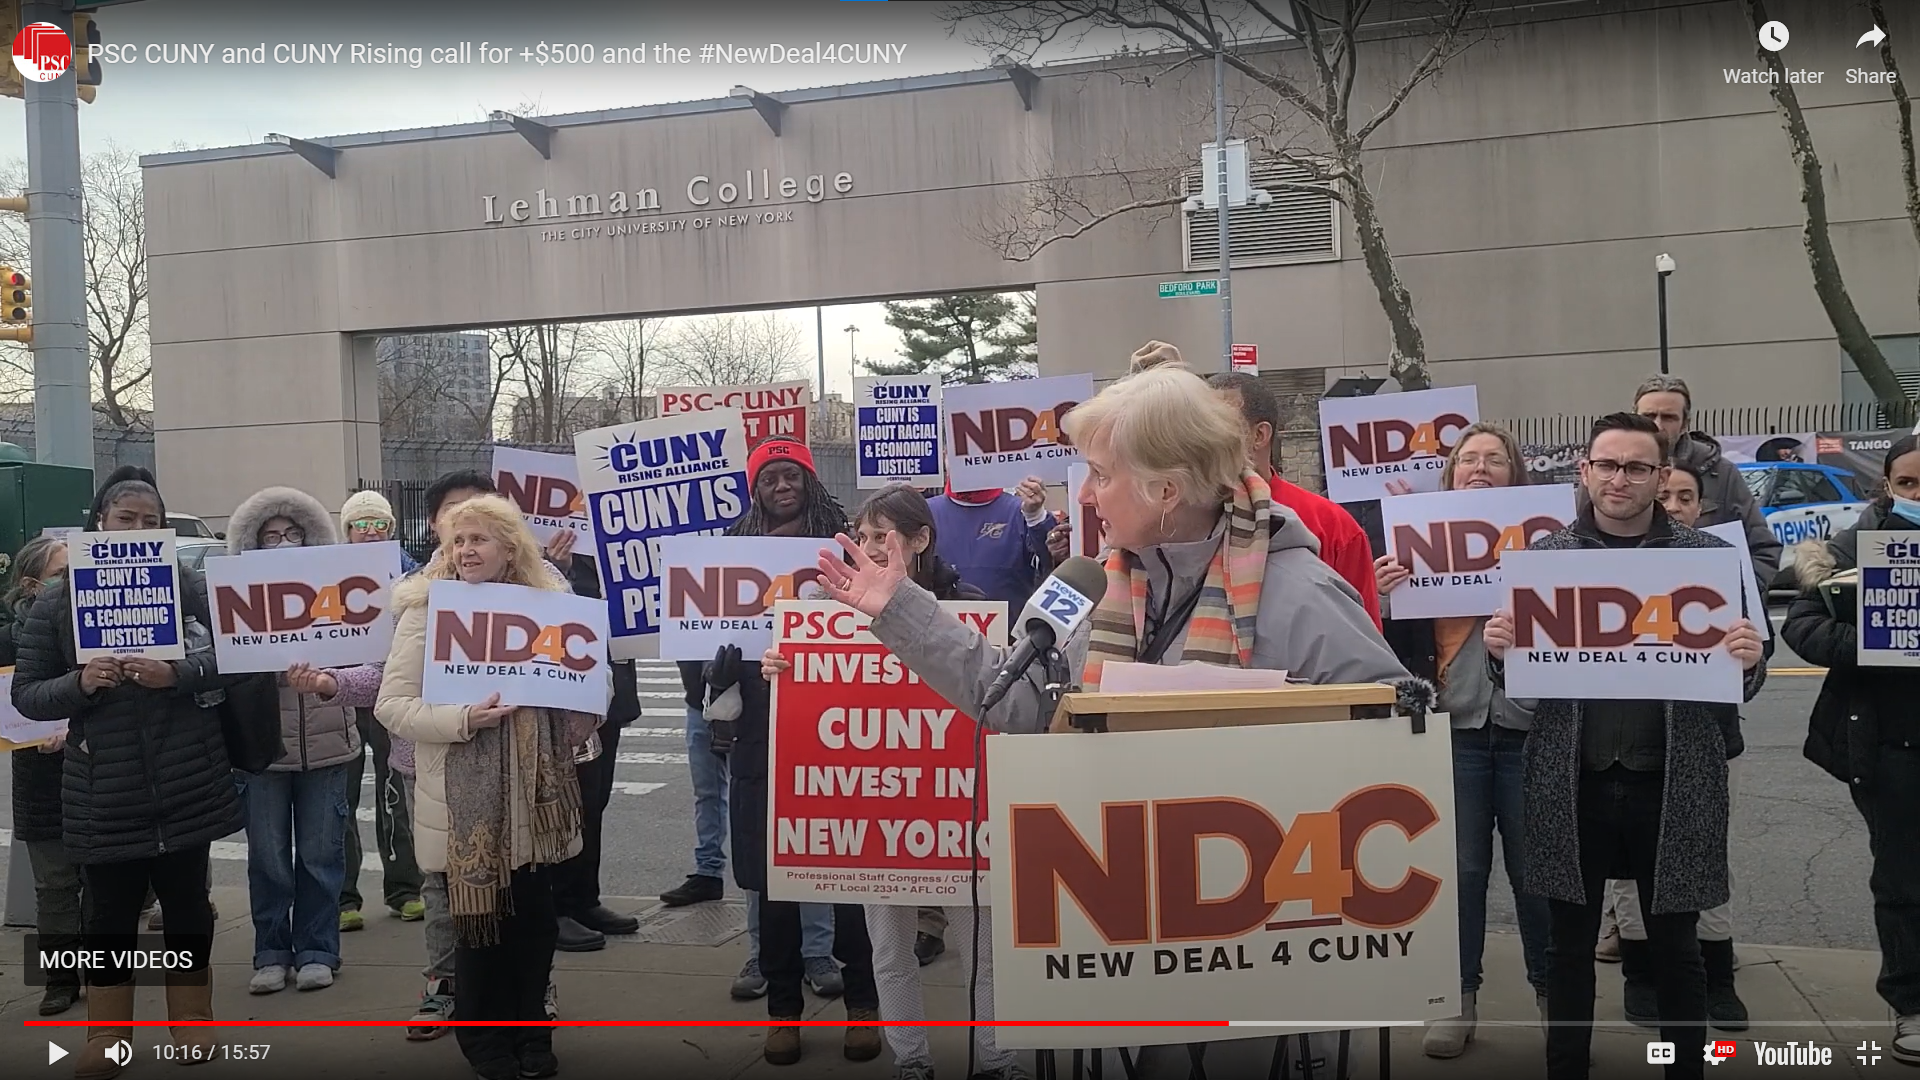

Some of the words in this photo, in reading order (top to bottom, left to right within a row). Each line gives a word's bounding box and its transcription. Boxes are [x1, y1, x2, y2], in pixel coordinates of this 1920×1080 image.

[482, 186, 661, 224] Lehman
[686, 168, 854, 205] College
[541, 230, 565, 242] THE
[571, 227, 601, 240] CITY
[607, 219, 687, 237] UNIVERSITY
[693, 217, 712, 230] OF
[718, 214, 749, 228] NEW
[755, 210, 793, 225] YORK
[1160, 283, 1193, 293] BEDFORD
[1196, 281, 1216, 290] PARK
[662, 386, 804, 413] PSC-CUNY
[873, 385, 932, 399] CUNY
[769, 413, 795, 436] IN
[876, 407, 906, 423] CUNY
[907, 406, 919, 423] IS
[860, 424, 896, 441] ABOUT
[897, 423, 937, 440] RACIAL
[1328, 413, 1471, 469] ND4C
[610, 428, 727, 473] CUNY
[768, 446, 790, 455] PSC
[864, 444, 873, 458] &
[875, 440, 933, 458] ECONOMIC
[1848, 439, 1892, 450] TANGO
[877, 458, 921, 475] JUSTICE
[965, 456, 992, 466] NEW
[998, 453, 1030, 463] DEAL
[1035, 451, 1043, 459] 4
[1047, 447, 1079, 458] CUNY
[618, 468, 663, 484] RISING
[665, 459, 730, 477] ALLIANCE
[1342, 467, 1370, 478] NEW
[1375, 464, 1408, 475] DEAL
[1413, 462, 1421, 471] 4
[1426, 461, 1448, 470] CU
[599, 482, 691, 536] CUNY
[699, 476, 743, 522] IS
[533, 516, 564, 528] DEAL
[568, 521, 576, 529] 4
[91, 541, 165, 559] CUNY
[95, 558, 123, 566] RISING
[96, 567, 133, 587] CUNY
[135, 567, 151, 586] IS
[1409, 575, 1444, 588] NEW
[1451, 574, 1492, 586] DEAL
[77, 588, 122, 608] ABOUT
[124, 586, 174, 606] RACIAL
[1050, 580, 1086, 607] news
[1864, 588, 1920, 607] ABOUT
[214, 575, 382, 635] ND4C
[1039, 588, 1079, 626] 12
[84, 611, 95, 628] &
[96, 606, 169, 627] ECONOMIC
[680, 620, 713, 630] NEW
[720, 620, 759, 630] DEAL
[764, 620, 773, 631] 4
[782, 611, 999, 640] PSC-Y
[1511, 584, 1729, 650] ND4C
[1870, 611, 1884, 628] &
[1886, 608, 1920, 628] ECO
[101, 627, 155, 647] JUSTICE
[232, 635, 263, 646] NEW
[269, 632, 308, 644] DEAL
[314, 630, 323, 641] 4
[329, 626, 371, 639] CUNY
[433, 609, 598, 672] ND4C
[1889, 629, 1920, 649] JUS
[1528, 651, 1569, 663] NEW
[1578, 651, 1628, 663] DEAL
[1636, 651, 1648, 663] 4
[1655, 651, 1712, 664] CUNY
[444, 664, 480, 675] NEW
[486, 665, 526, 676] DEAL
[532, 667, 541, 677] 4
[547, 669, 587, 684] CUNY
[817, 707, 957, 751] CUNY
[794, 765, 922, 798] INVEST
[934, 767, 976, 799] IN
[777, 817, 869, 857] NEW
[878, 819, 991, 859] YORK
[1008, 782, 1444, 949] ND4C
[787, 871, 856, 881] Professional
[859, 873, 885, 882] Staff
[888, 874, 942, 885] Congress
[814, 883, 837, 892] AFT
[840, 883, 870, 893] Local
[873, 884, 899, 893] 2334
[910, 886, 933, 894] AFL
[936, 886, 957, 895] CIO
[1045, 950, 1135, 980] NEW
[1153, 943, 1254, 976] DEAL
[1271, 940, 1292, 966] 4
[1307, 931, 1415, 964] CUNY
